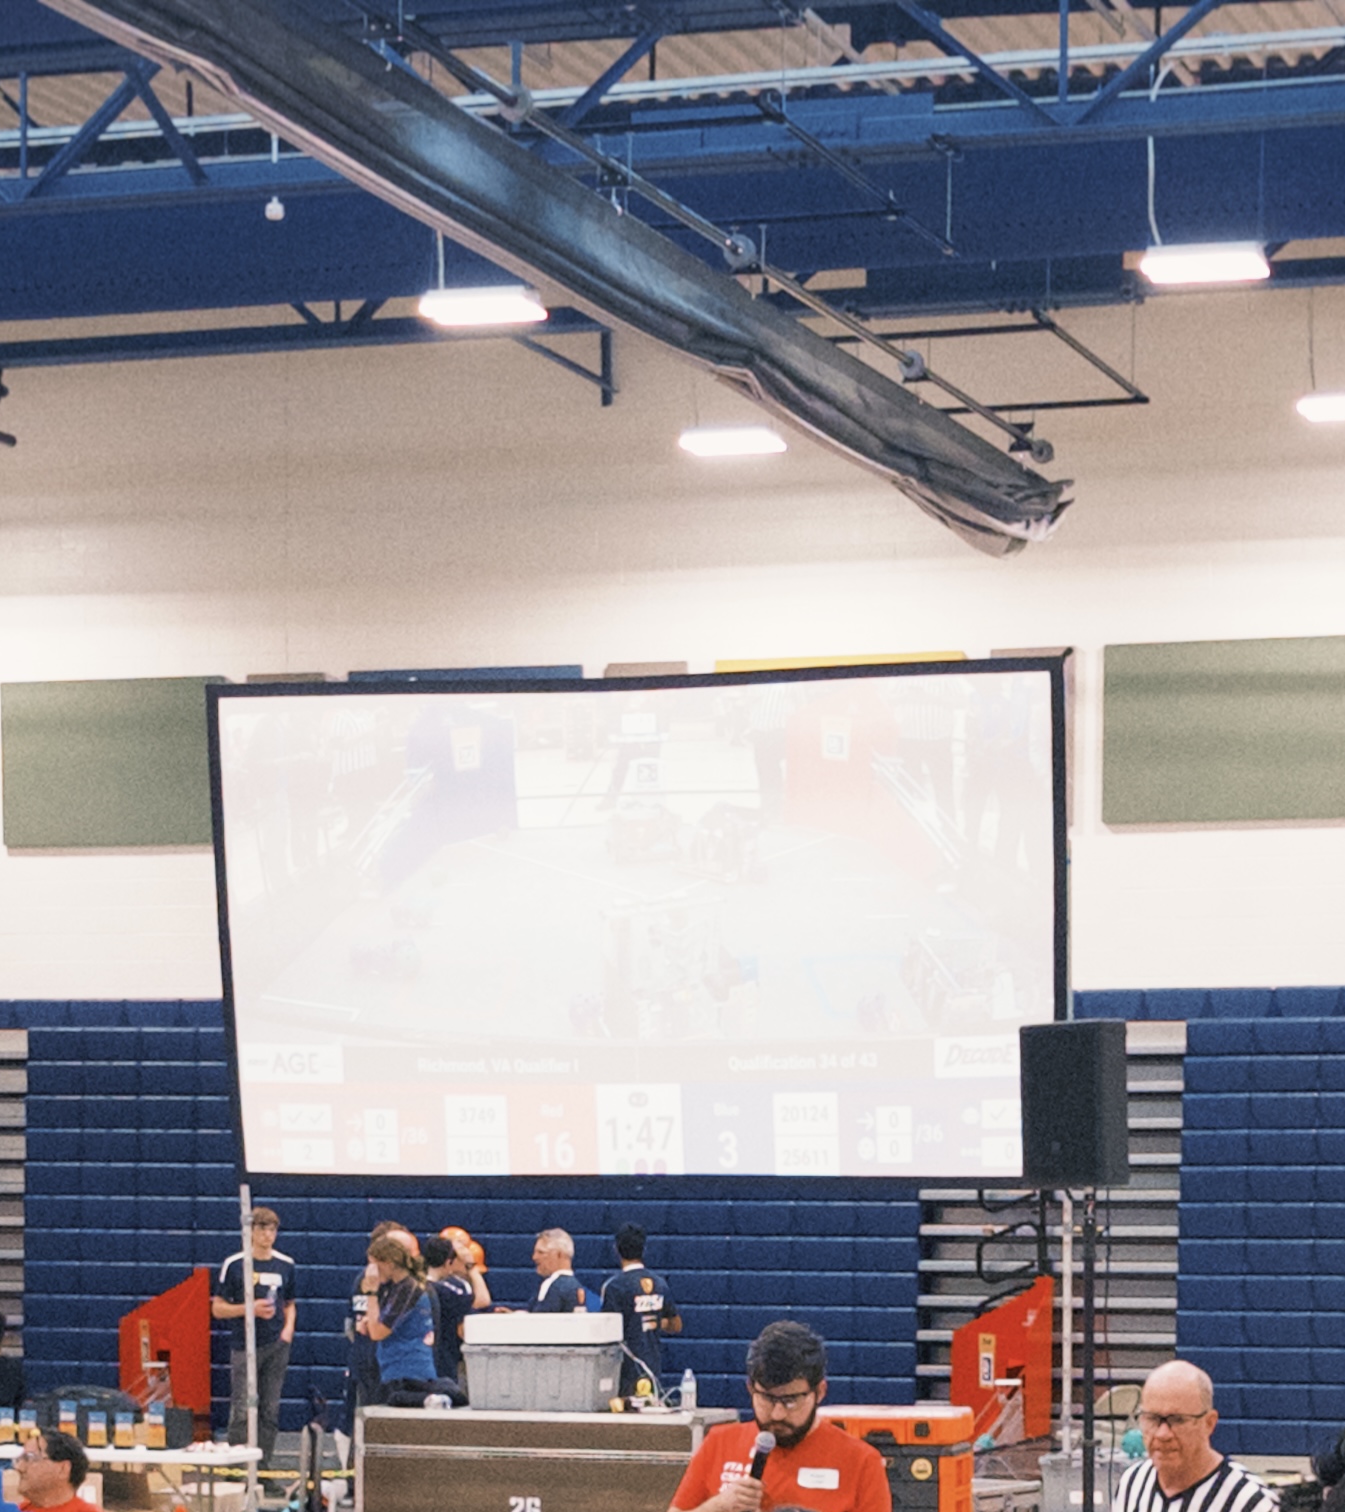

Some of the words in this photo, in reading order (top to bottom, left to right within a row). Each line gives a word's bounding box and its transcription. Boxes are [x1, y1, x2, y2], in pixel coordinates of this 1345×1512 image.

[272, 1052, 321, 1075] AGE
[490, 1057, 511, 1072] VA
[728, 1054, 816, 1072] Qualification
[819, 1053, 837, 1069] 34
[841, 1053, 856, 1068] of
[859, 1052, 878, 1068] 43
[459, 1107, 496, 1125] 3749
[781, 1105, 830, 1123] 20124
[604, 1115, 675, 1151] 1:47
[457, 1150, 502, 1168] 31201
[534, 1131, 576, 1170] 16
[718, 1130, 739, 1169] 3
[783, 1149, 830, 1167] 25611
